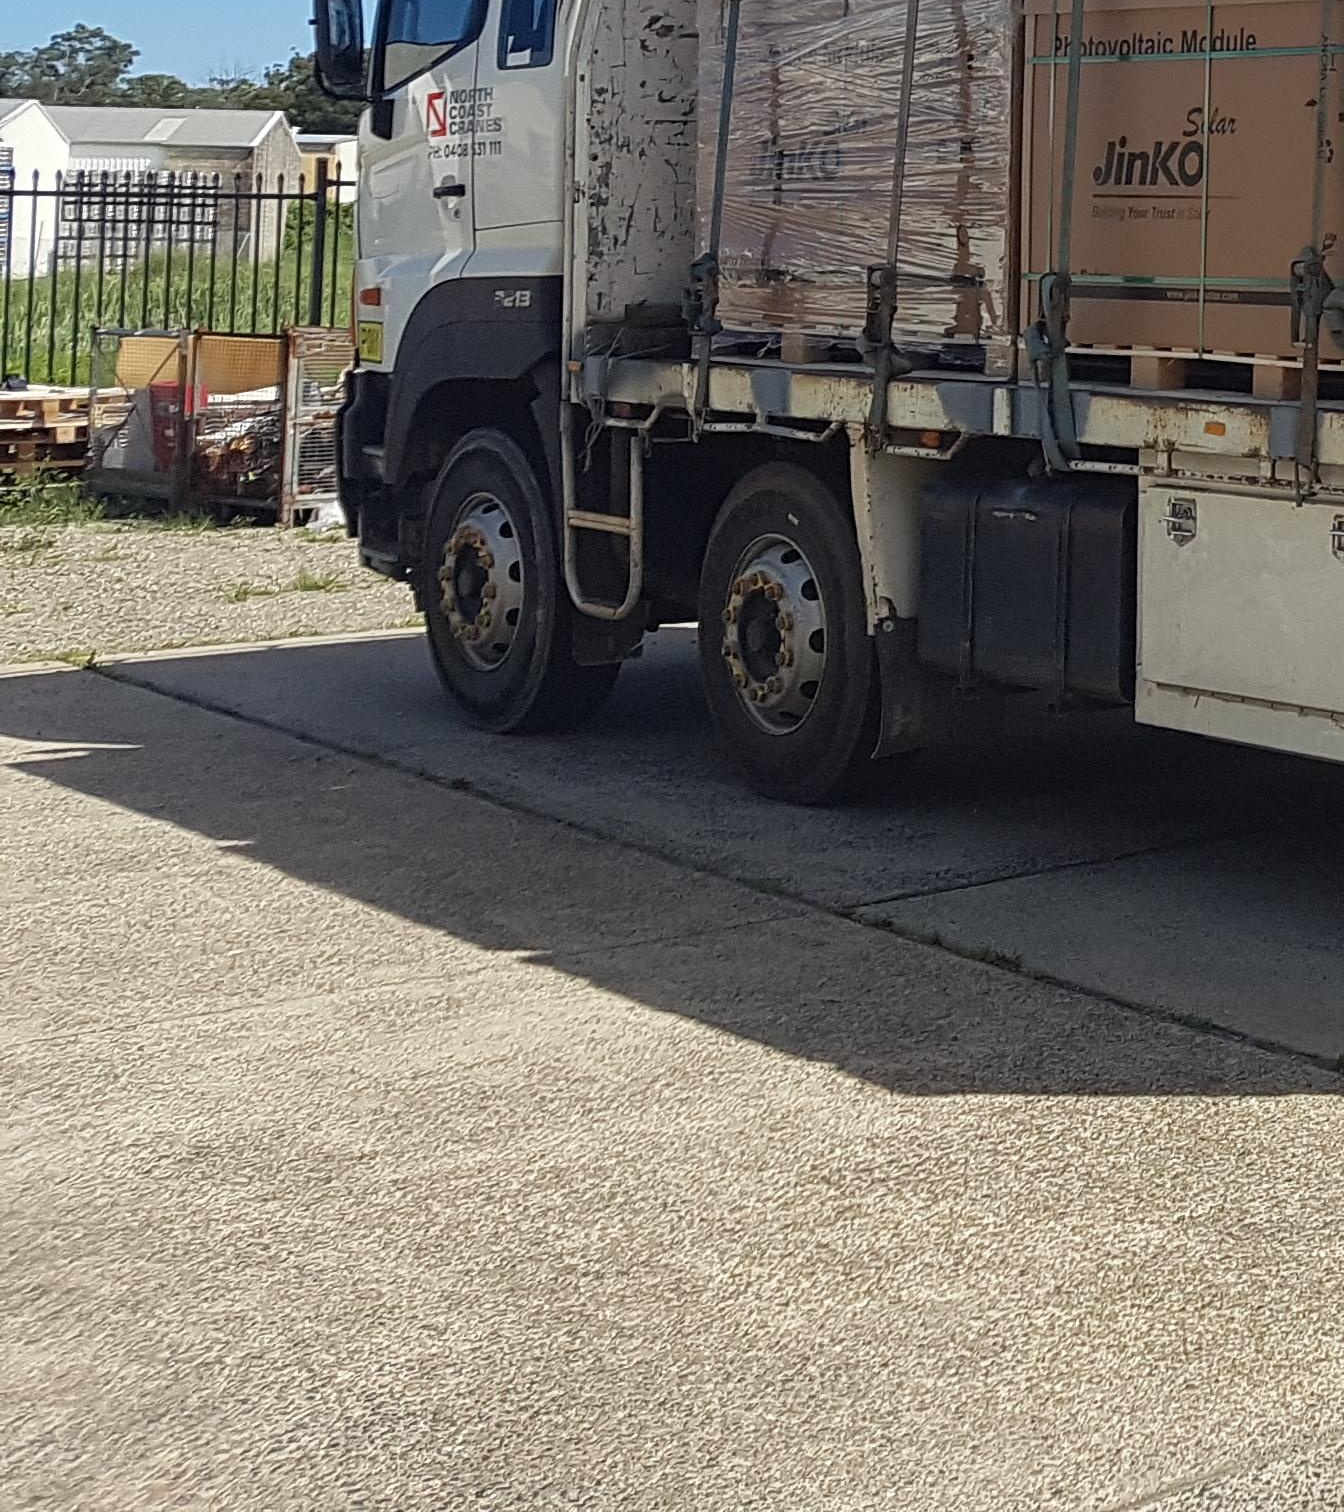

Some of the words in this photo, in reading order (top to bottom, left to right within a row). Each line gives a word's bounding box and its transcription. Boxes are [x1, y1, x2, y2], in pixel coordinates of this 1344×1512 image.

[449, 87, 494, 105] NORTH
[449, 103, 493, 120] COAST
[449, 117, 502, 135] CRANES
[1093, 136, 1205, 187] JinKO
